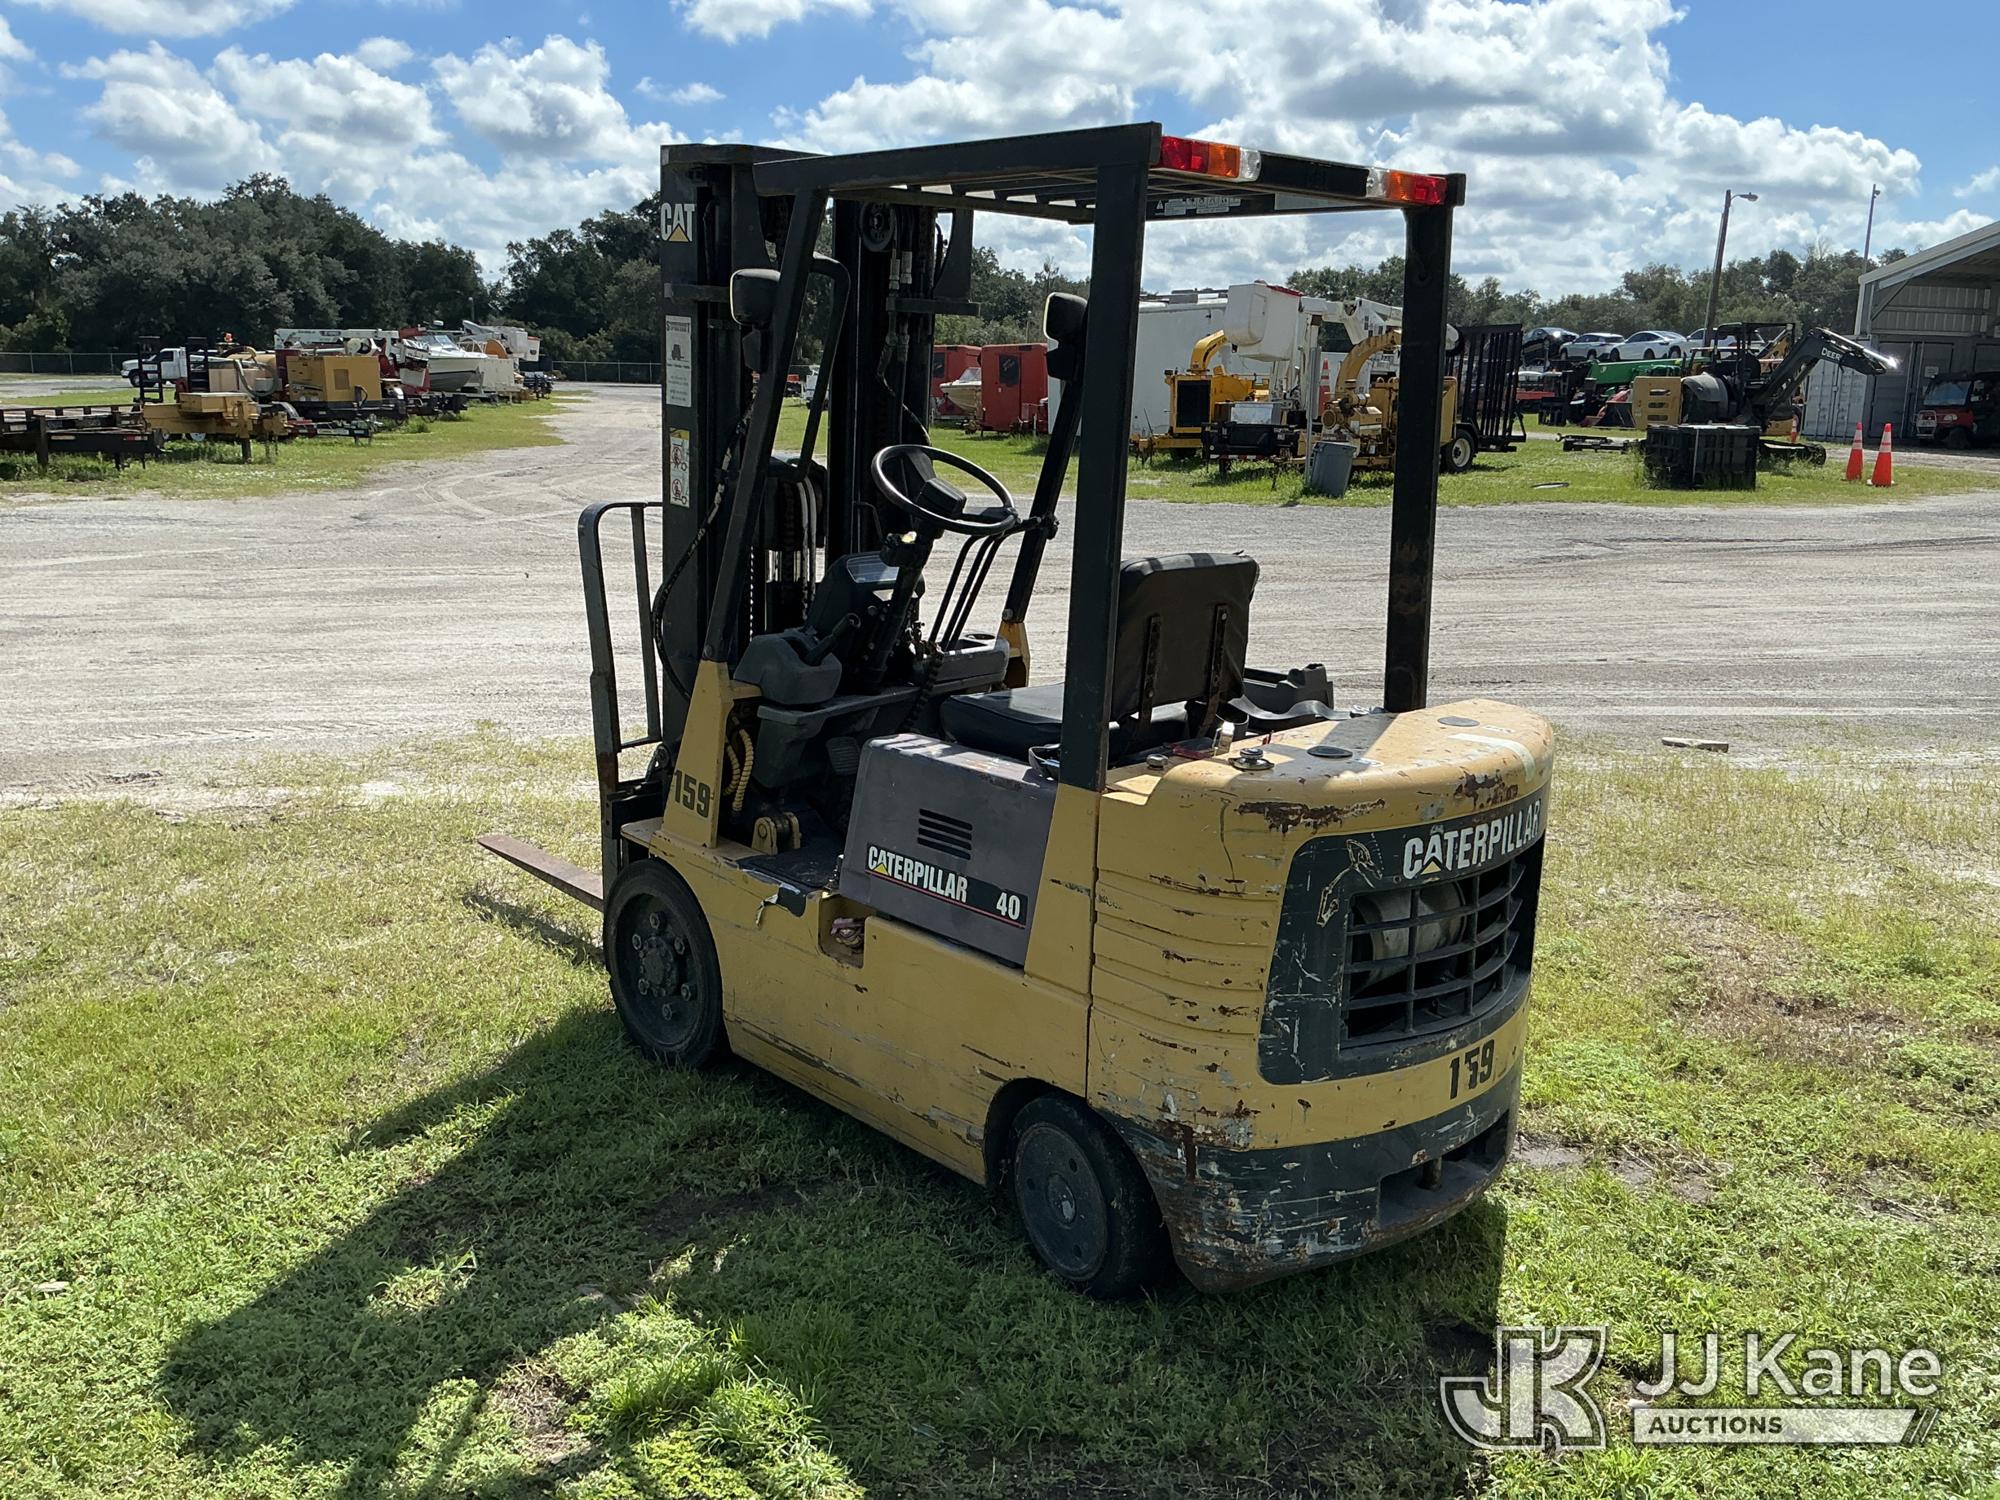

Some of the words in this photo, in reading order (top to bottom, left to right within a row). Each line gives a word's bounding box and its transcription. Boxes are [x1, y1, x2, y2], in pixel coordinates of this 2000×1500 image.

[660, 202, 695, 241] CAT
[1821, 347, 1843, 360] DEER
[674, 769, 710, 818] 159
[1403, 800, 1540, 879] CATERPILLAR
[868, 846, 968, 903] CATERPILLAR
[996, 892, 1020, 920] 40
[1449, 1039, 1494, 1100] 159
